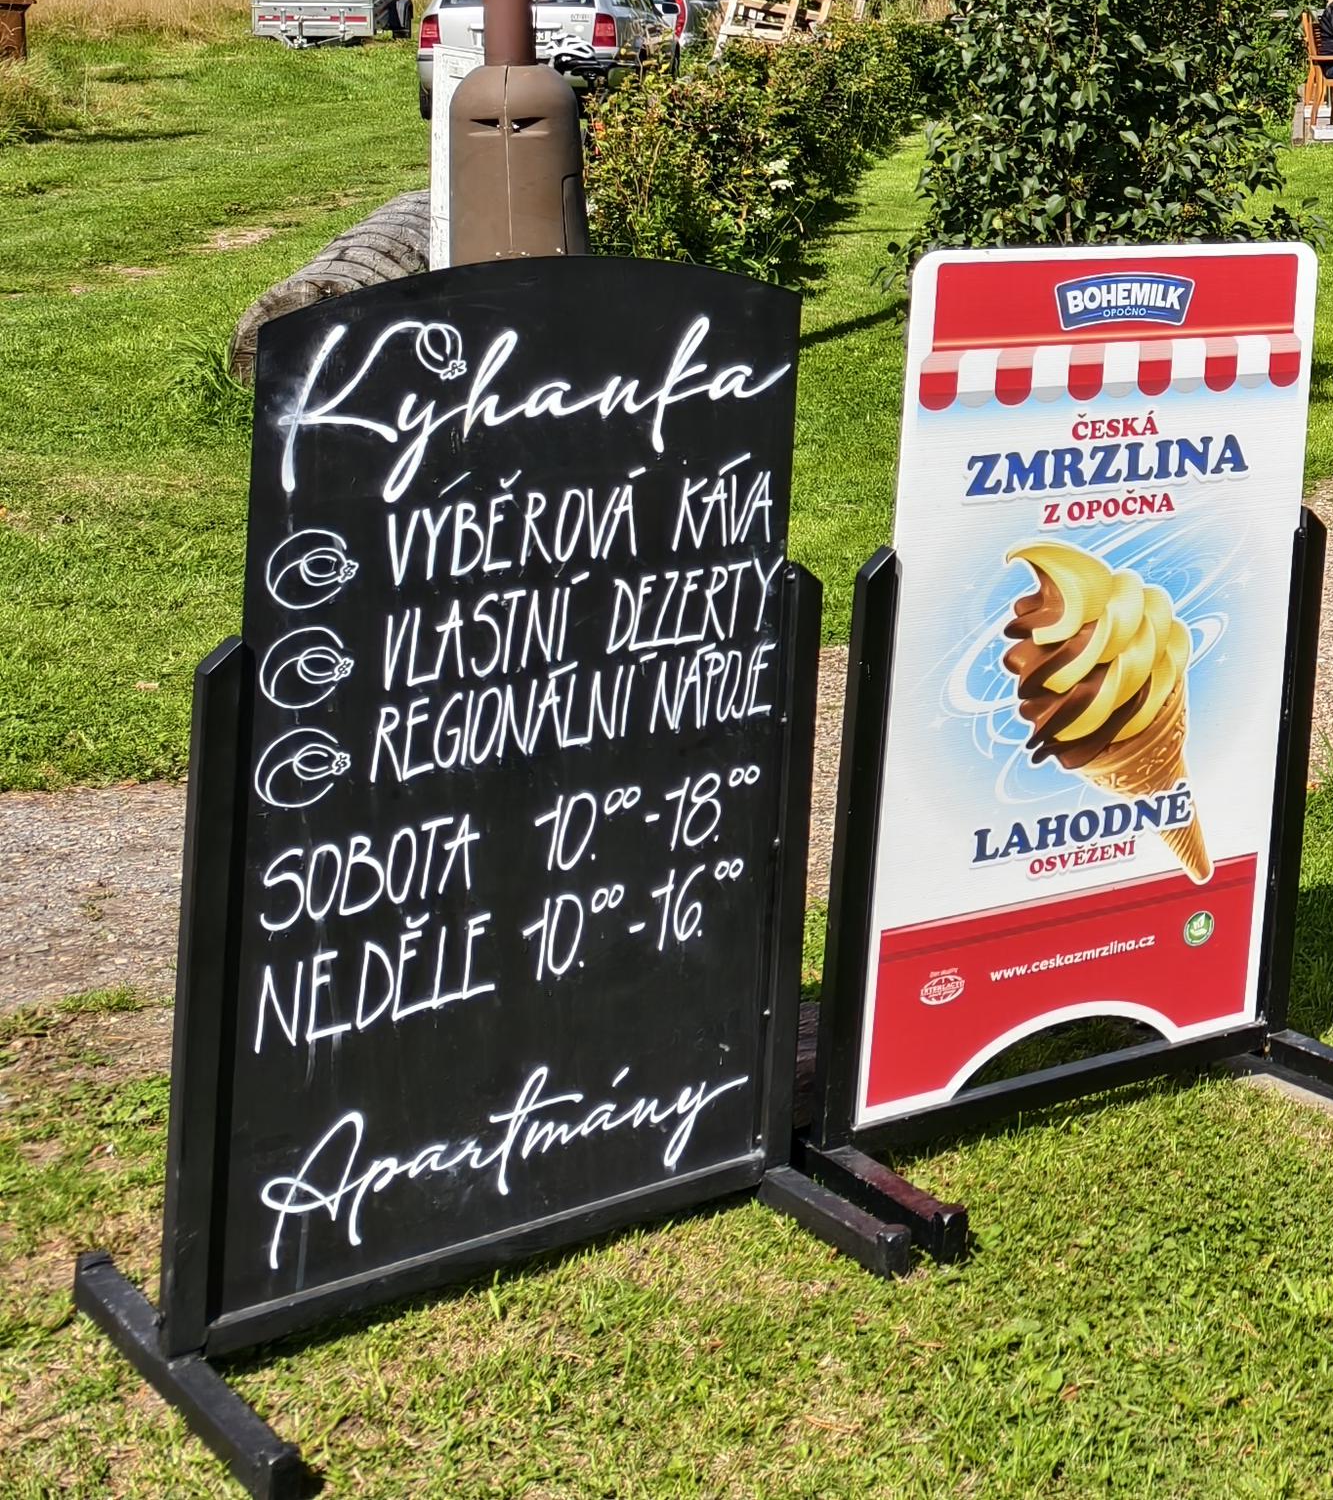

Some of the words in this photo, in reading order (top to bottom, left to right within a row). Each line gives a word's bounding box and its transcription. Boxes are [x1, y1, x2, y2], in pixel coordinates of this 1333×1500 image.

[1066, 282, 1185, 314] BOHEMILK
[1103, 306, 1147, 317] OPOČNO
[277, 316, 792, 503] Kyhanka
[1071, 410, 1159, 441] ČESKÁ
[966, 434, 1249, 498] ZMRZLINA
[386, 468, 647, 586] VÝBĚROVÁ
[672, 452, 773, 552] KÁVA
[1043, 502, 1061, 525] Z
[1067, 491, 1175, 521] OPOČNA
[383, 577, 588, 691] VLASTNÍ
[605, 556, 785, 655] DEZERTY
[370, 651, 658, 783] REGIONÁLNÍ
[649, 643, 776, 734] NÁPOJE
[971, 783, 1192, 864] LAHODNÉ
[1029, 836, 1136, 875] OSVĚŽENÍ
[260, 813, 480, 931] SOBOTA
[254, 912, 496, 1053] NEDĚLE
[990, 934, 1155, 982] www.ceskazmrzlina.cz
[261, 1065, 749, 1270] Apartmány
